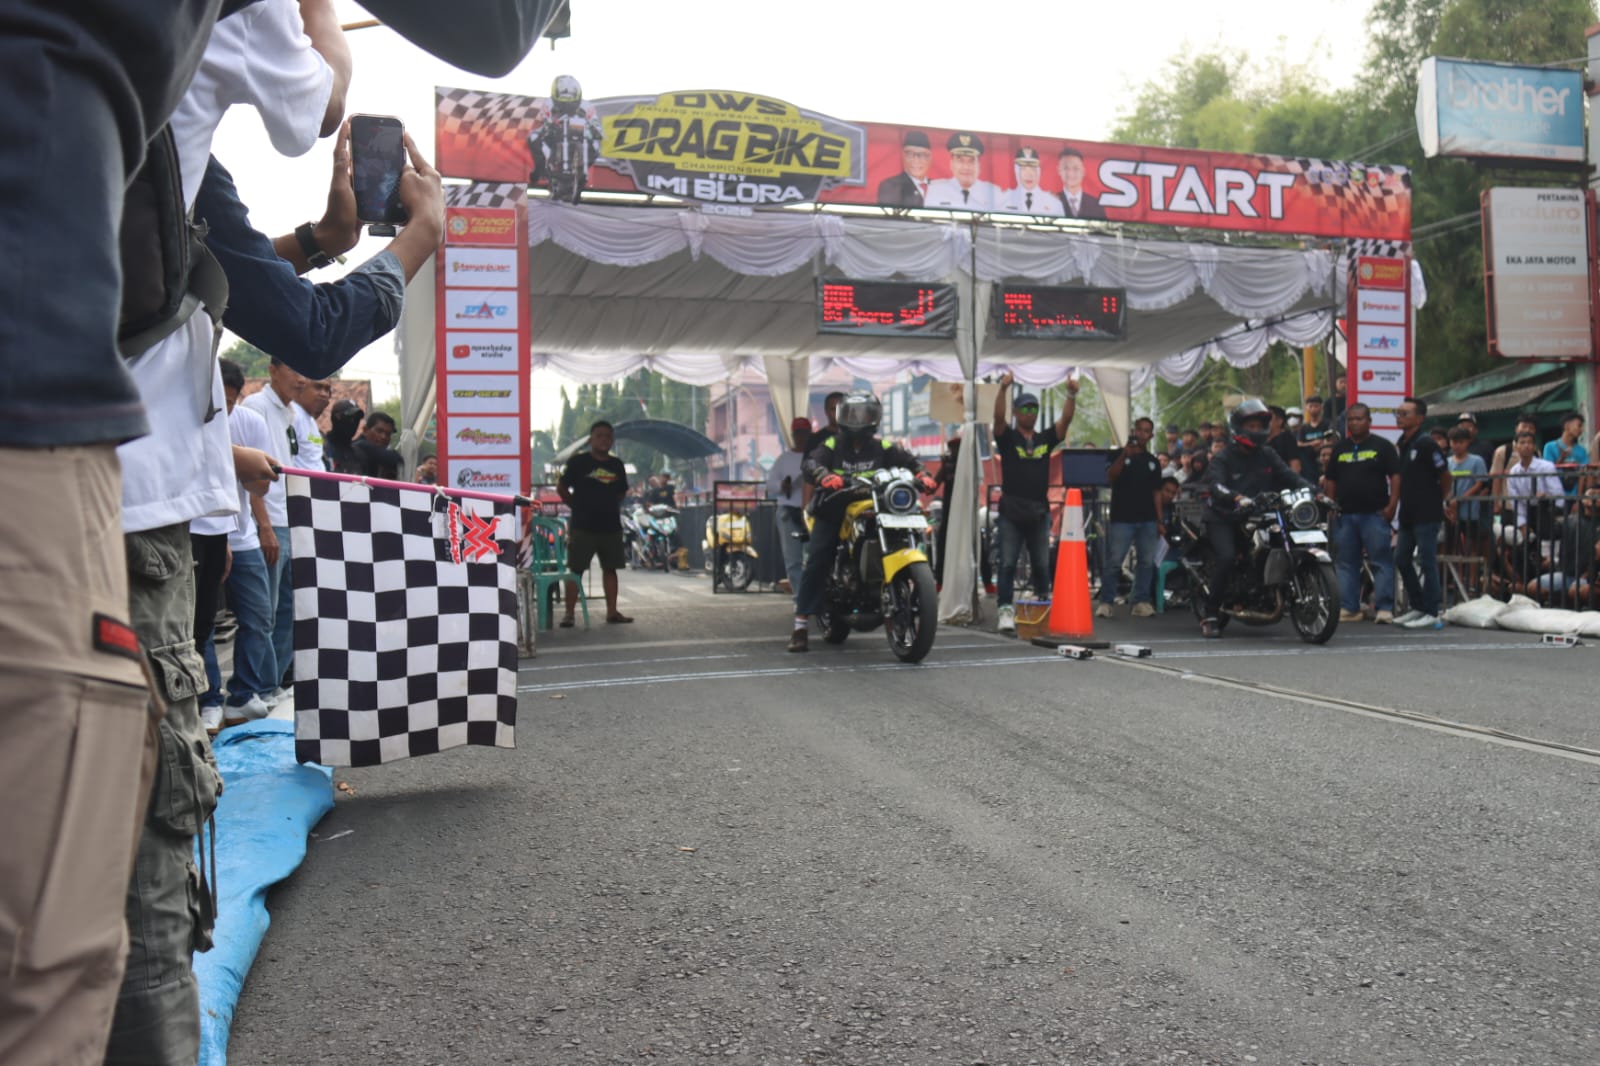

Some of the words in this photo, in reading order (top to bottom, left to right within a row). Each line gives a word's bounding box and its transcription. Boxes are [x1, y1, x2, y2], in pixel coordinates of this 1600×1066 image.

[1448, 71, 1571, 116] brother
[674, 93, 787, 116] DWS
[681, 162, 774, 175] CHAMPIONSHIP
[709, 172, 746, 182] FEAT
[647, 174, 688, 195] IMI
[693, 178, 804, 203] BLORA
[1098, 159, 1296, 219] START
[1537, 193, 1580, 202] PERTAMINA
[1505, 256, 1522, 265] EKA
[1524, 256, 1544, 265] JAYA
[1546, 256, 1576, 265] MOTOR
